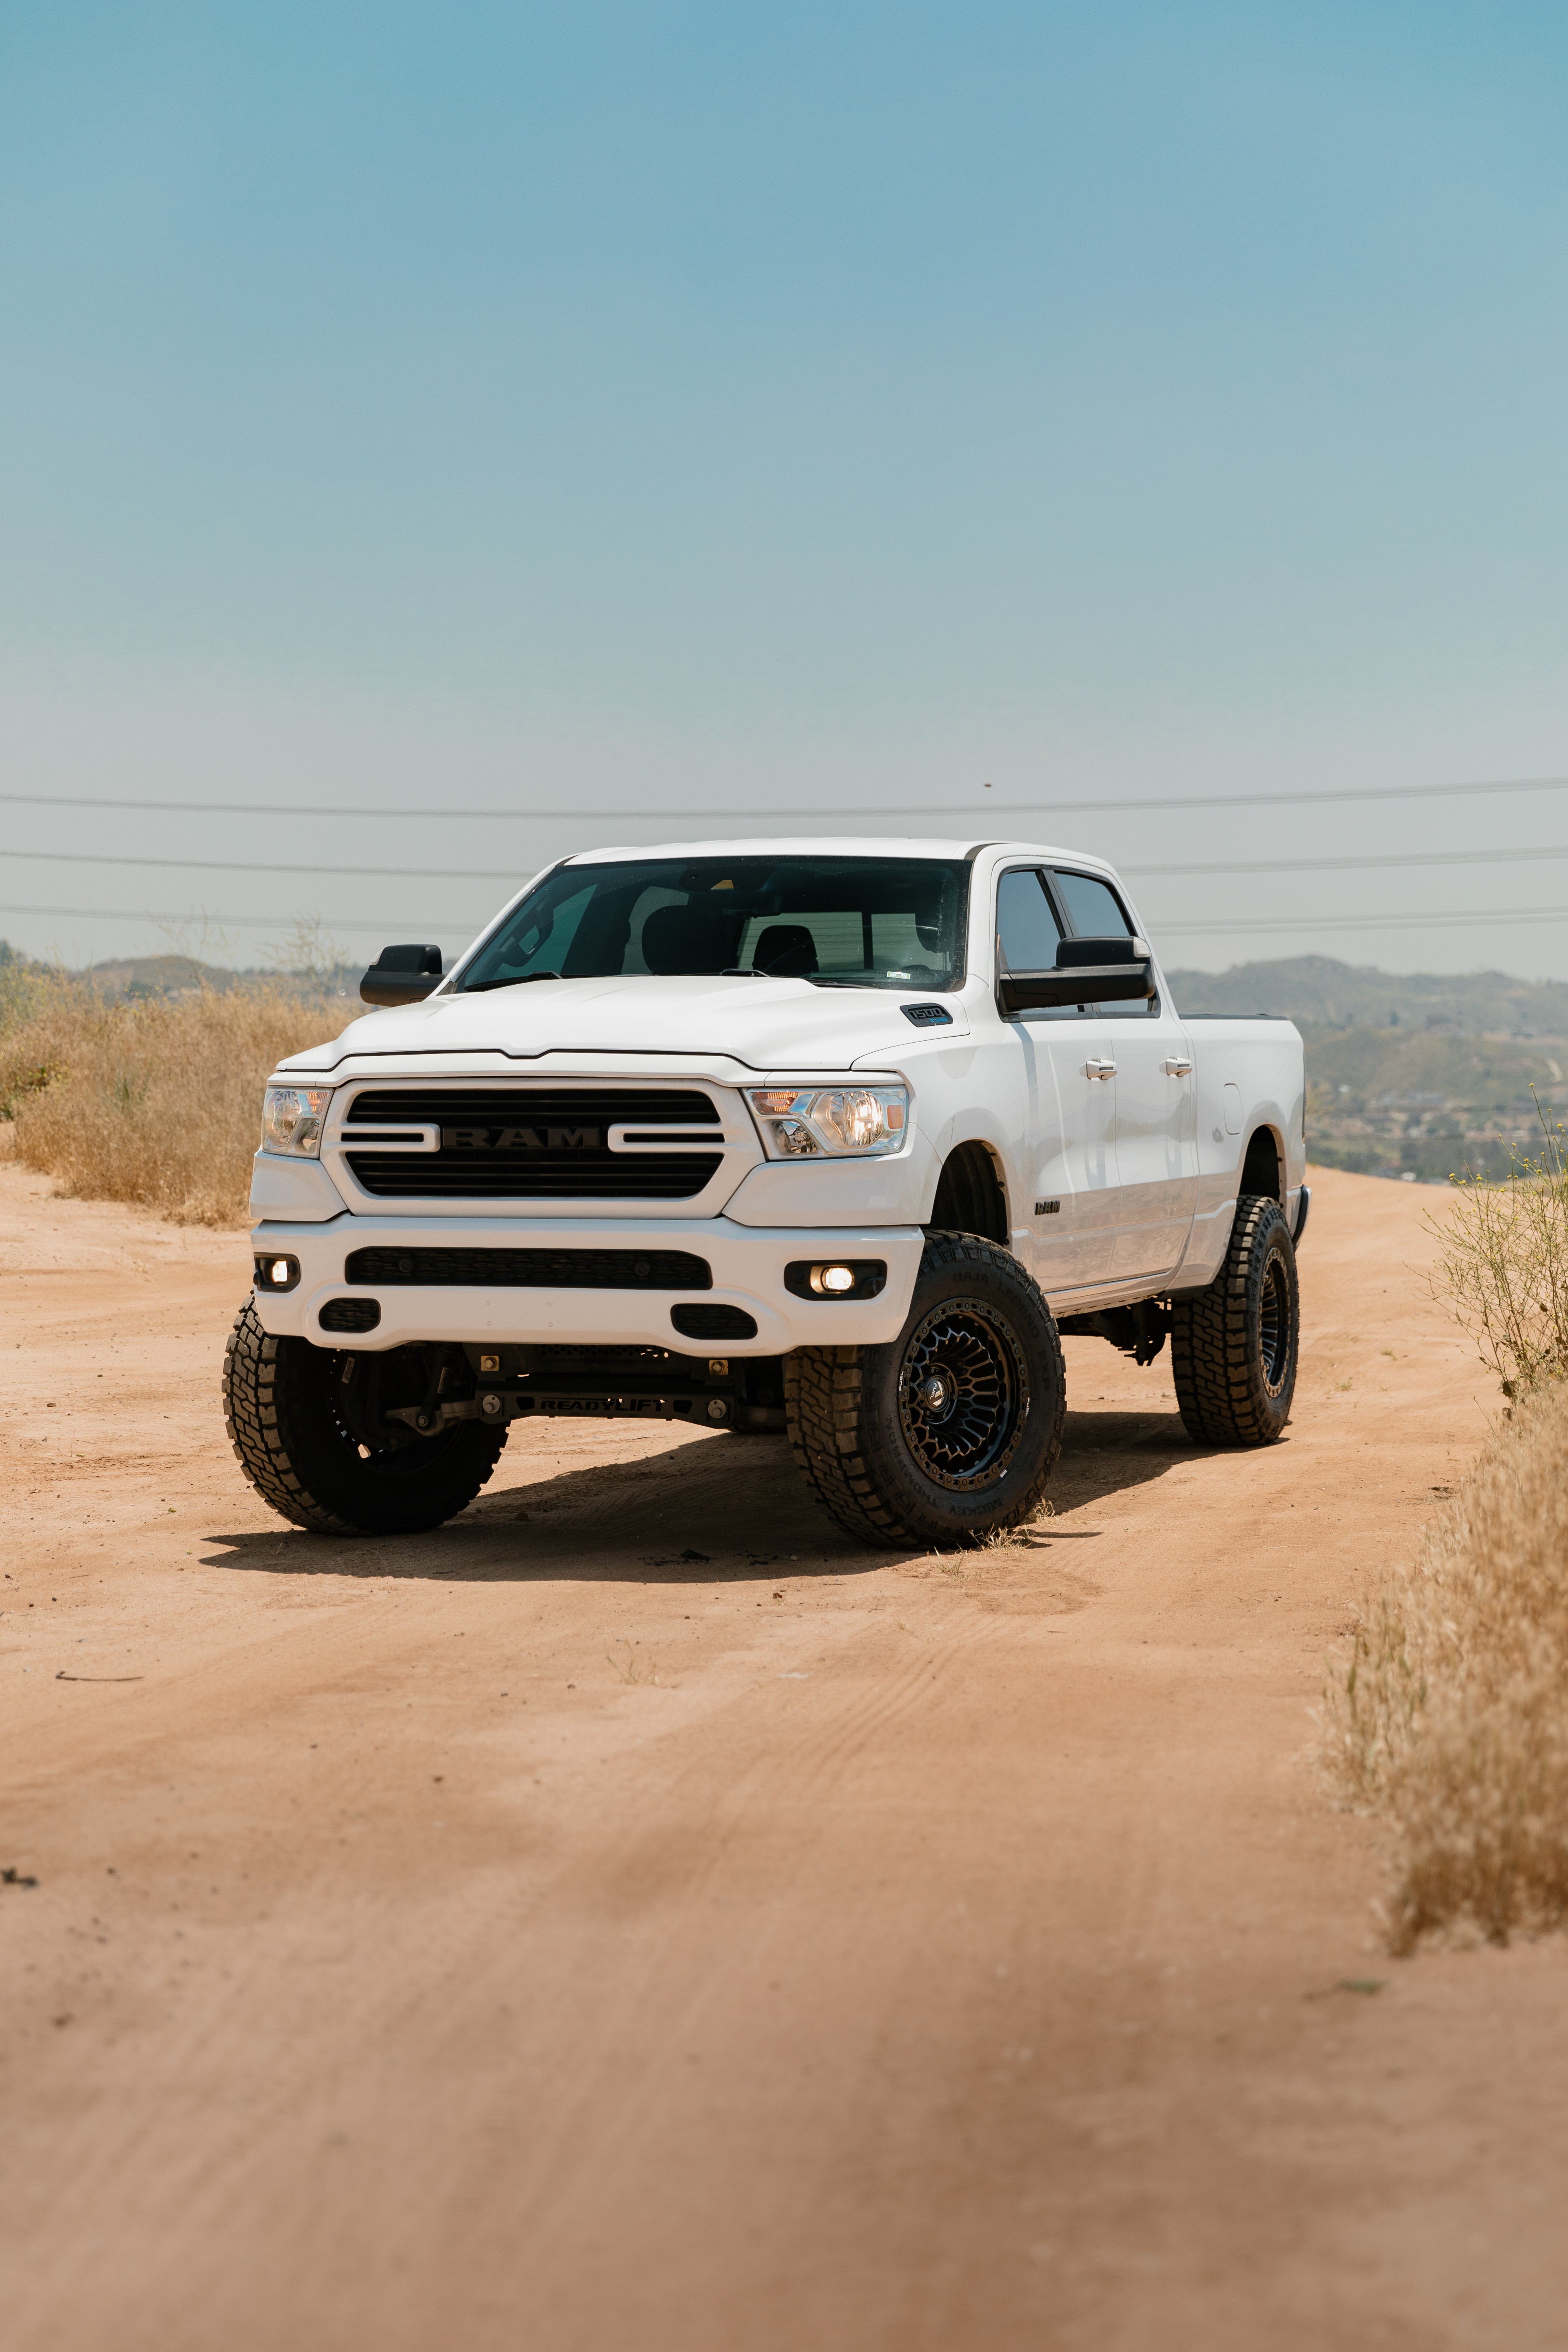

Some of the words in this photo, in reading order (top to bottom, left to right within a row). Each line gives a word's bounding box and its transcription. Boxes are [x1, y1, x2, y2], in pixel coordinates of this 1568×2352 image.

[909, 1008, 942, 1018] 1500
[442, 1126, 599, 1148] RAM
[1035, 1200, 1060, 1215] RAM
[953, 1271, 989, 1284] BAJA
[540, 1399, 667, 1412] READYLIFT
[886, 1418, 939, 1508] THOMPSON
[949, 1498, 1003, 1516] MICKEY
